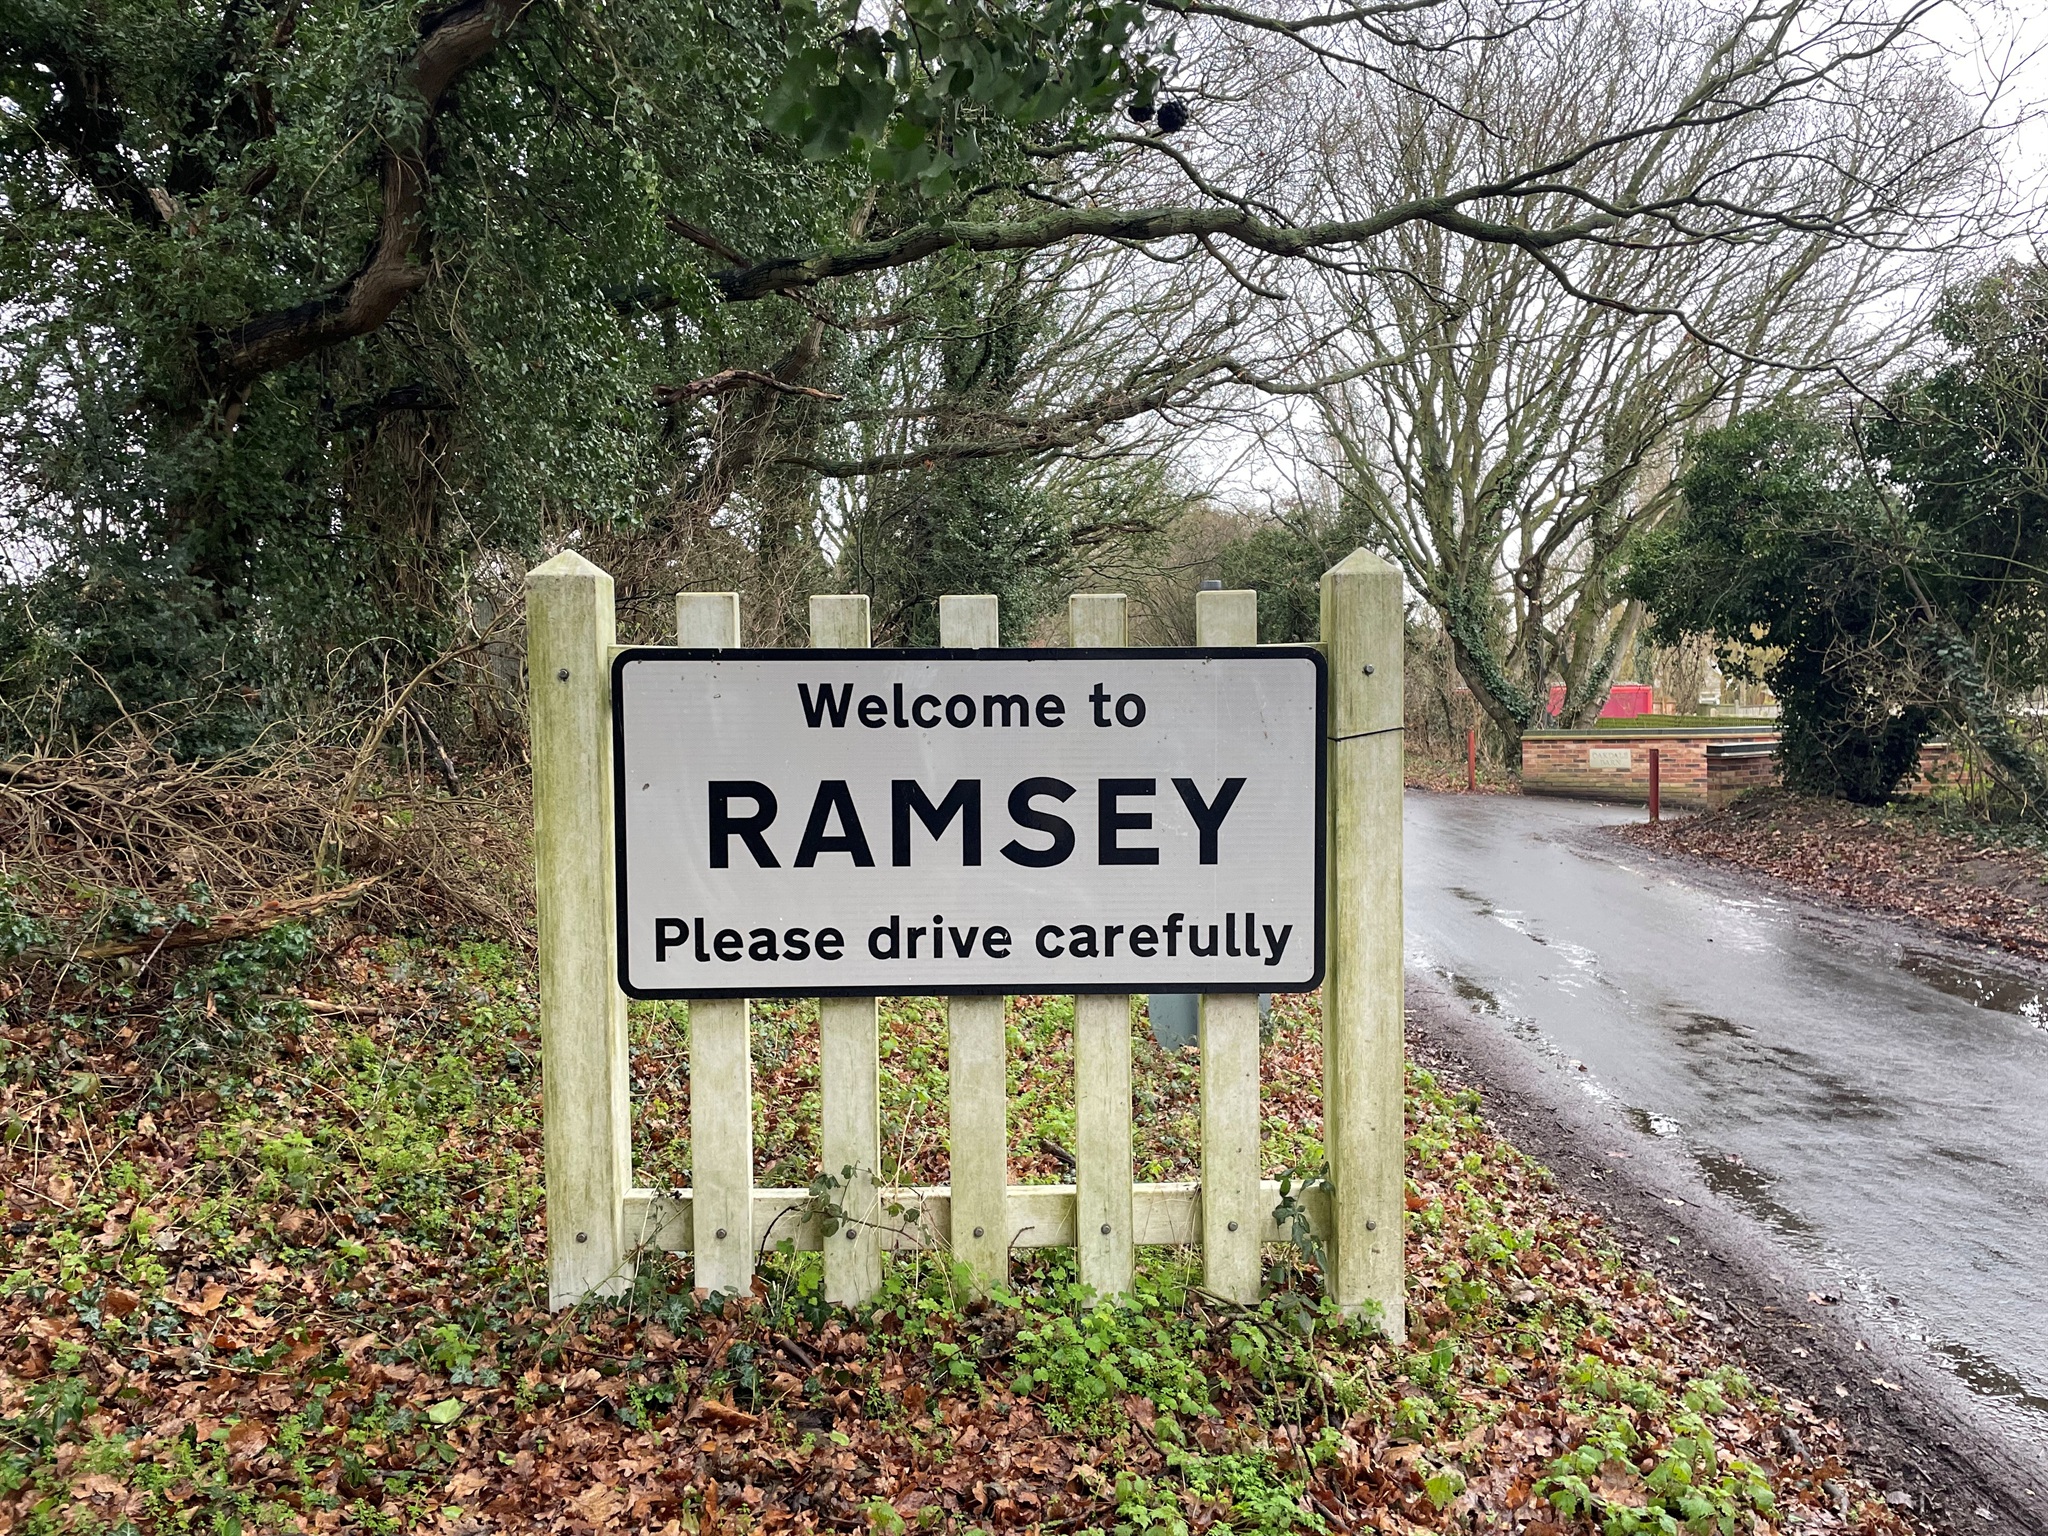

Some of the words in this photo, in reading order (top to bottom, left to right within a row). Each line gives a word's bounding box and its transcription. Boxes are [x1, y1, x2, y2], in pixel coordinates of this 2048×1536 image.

[797, 683, 1066, 729] Welcome
[1089, 682, 1147, 728] to
[708, 776, 1248, 869] RAMSEY
[655, 917, 845, 963] Please
[868, 914, 1012, 961] drive
[1035, 912, 1294, 967] carefully
